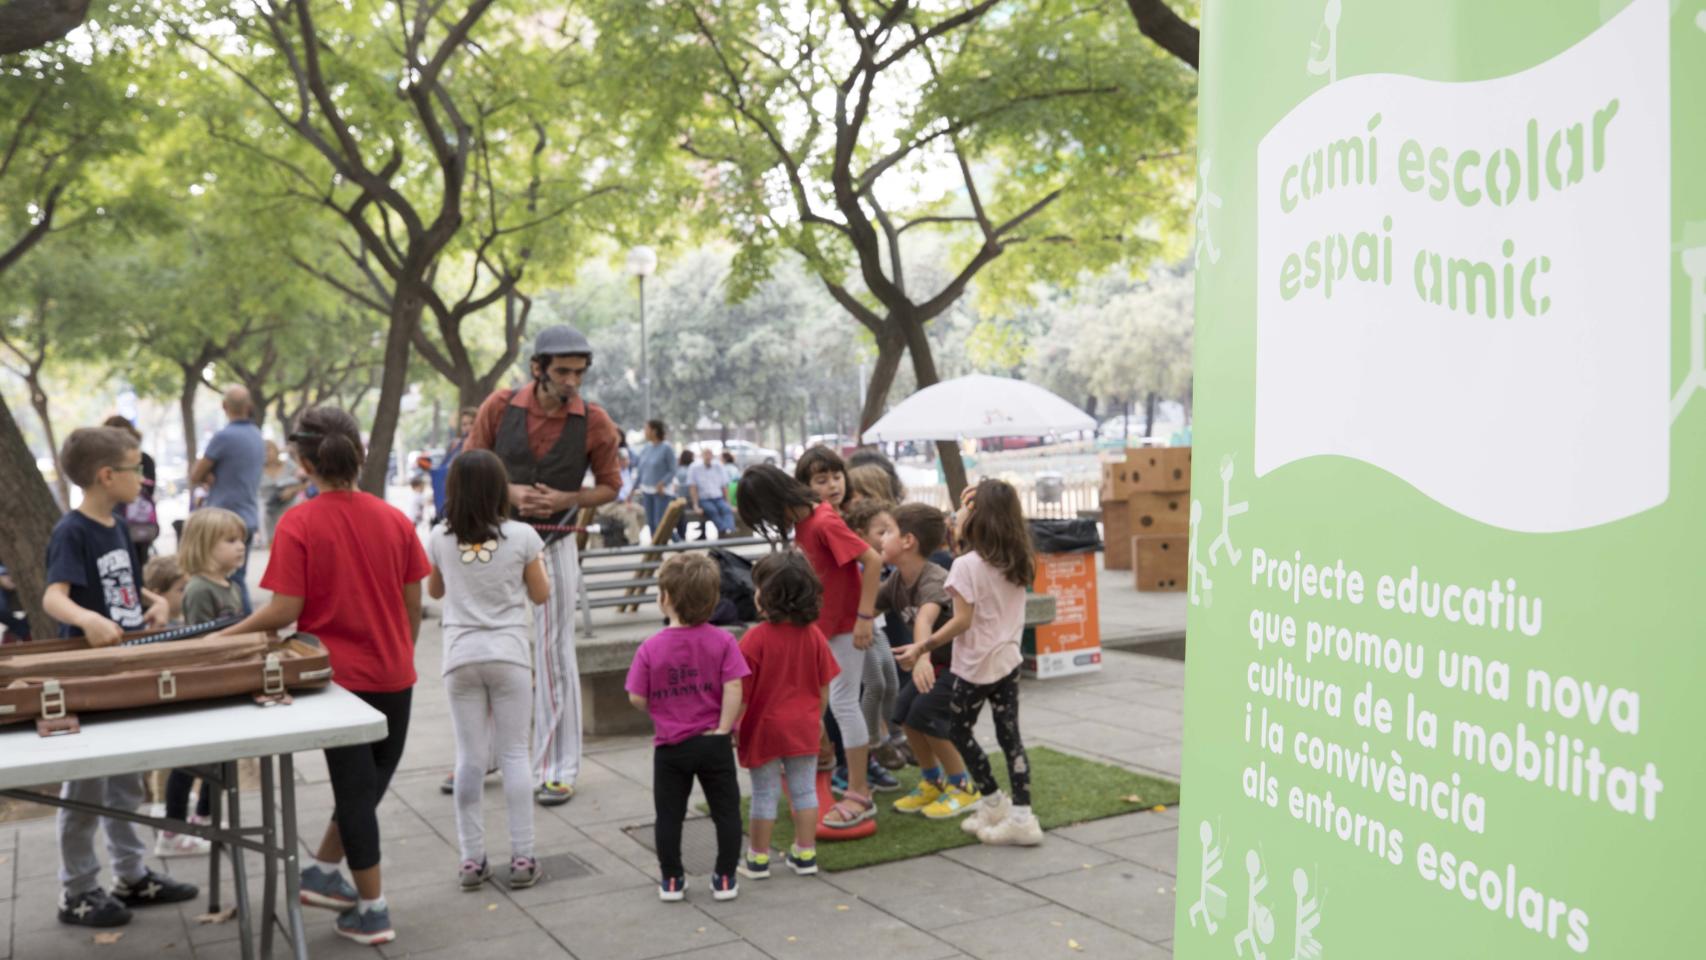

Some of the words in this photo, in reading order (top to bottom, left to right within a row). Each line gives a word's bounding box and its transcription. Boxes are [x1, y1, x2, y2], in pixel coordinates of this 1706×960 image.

[1280, 112, 1382, 214] camí
[1398, 97, 1620, 208] escolar
[1279, 215, 1393, 301] espai
[1413, 239, 1552, 320] amic
[1251, 547, 1365, 604] Projecte
[1376, 565, 1542, 636] educatiu
[652, 681, 713, 699] MYANMR
[1249, 609, 1297, 650] que
[1306, 620, 1424, 679] promou
[1438, 649, 1510, 701] una
[1526, 668, 1640, 734] nova
[1244, 702, 1252, 742] i
[1260, 707, 1284, 754] la
[1294, 731, 1486, 833] convivència
[1247, 657, 1342, 717] cultura
[1353, 681, 1393, 733] de
[1406, 692, 1438, 748] la
[1453, 720, 1664, 821] mobilitat
[1242, 761, 1279, 807] als
[1288, 786, 1404, 865] entorns
[1416, 843, 1590, 952] escolars
